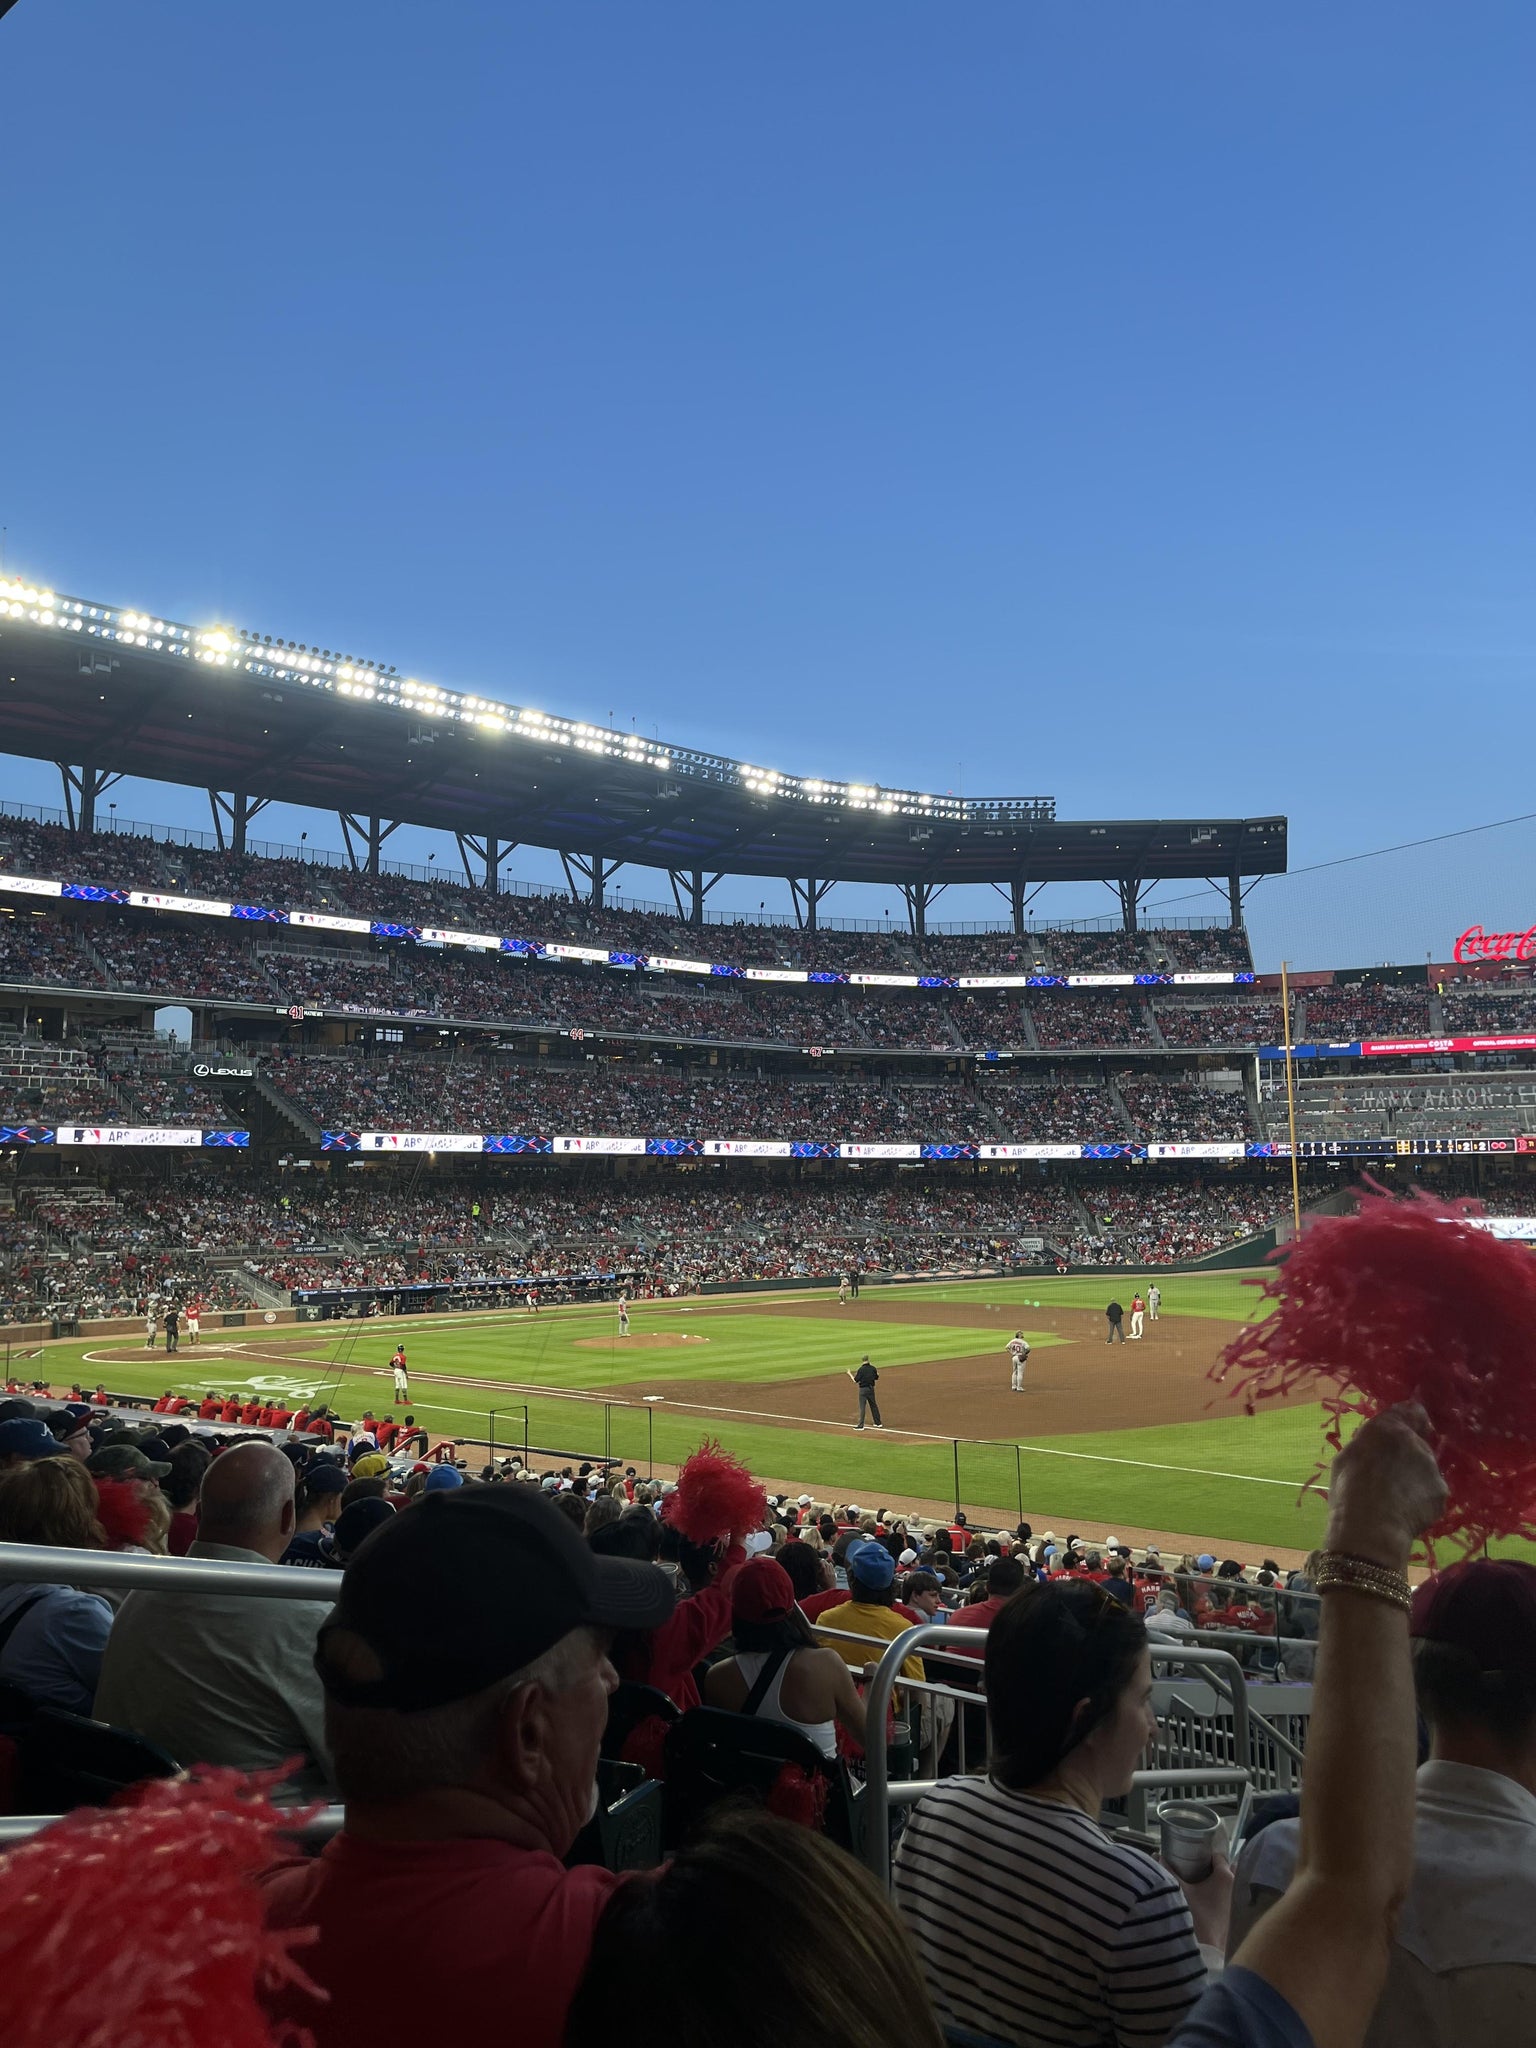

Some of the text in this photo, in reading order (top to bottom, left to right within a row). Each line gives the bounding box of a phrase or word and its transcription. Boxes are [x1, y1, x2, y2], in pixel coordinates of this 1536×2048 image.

[289, 1005, 304, 1019] 41
[570, 1028, 584, 1041] 44
[1428, 1040, 1454, 1048] COSTA
[210, 1067, 252, 1076] LEXUS
[1362, 1088, 1413, 1108] HANK
[1424, 1086, 1494, 1107] AARON
[1141, 1583, 1160, 1593] HARR
